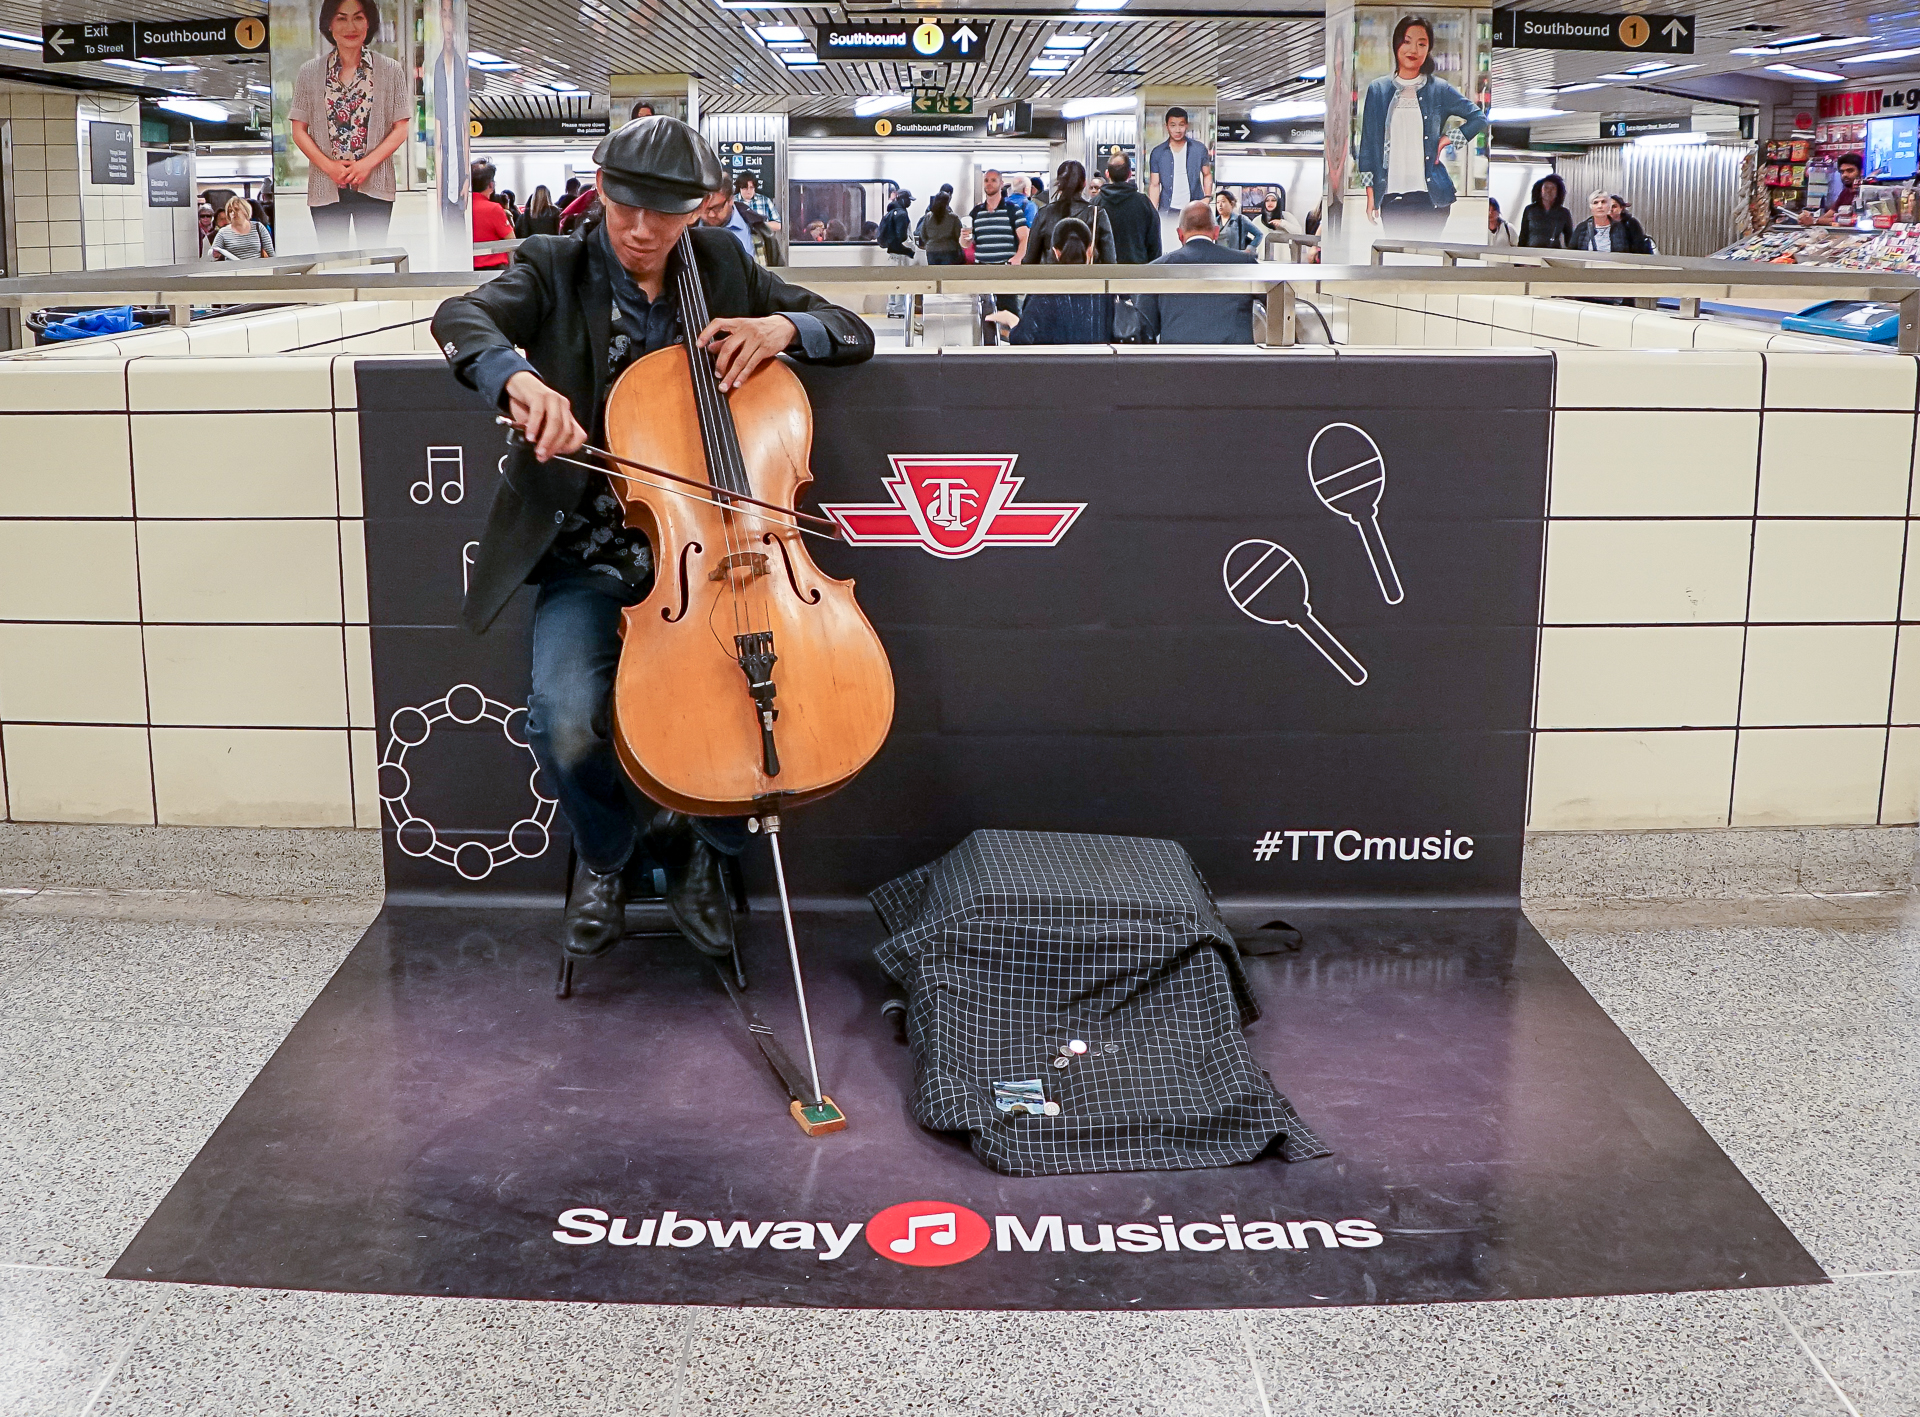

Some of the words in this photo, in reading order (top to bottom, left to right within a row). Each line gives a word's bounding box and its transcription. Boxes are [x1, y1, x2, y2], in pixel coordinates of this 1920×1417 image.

[84, 25, 109, 37] Exit
[143, 28, 226, 44] Southbound
[244, 24, 253, 41] 1
[1524, 21, 1610, 37] Southbound
[1629, 22, 1638, 40] 1
[829, 32, 907, 46] Southbound
[924, 30, 931, 45] 1
[85, 45, 95, 54] To
[97, 44, 124, 53] Street
[471, 124, 476, 133] 1
[880, 123, 886, 132] 1
[896, 123, 942, 132] Southbound
[942, 123, 974, 132] Platform
[115, 129, 126, 142] Exit
[745, 156, 763, 166] Exit
[1253, 829, 1474, 862] #TTCmusic
[552, 1208, 863, 1261] Subway
[995, 1213, 1384, 1253] Musicians
